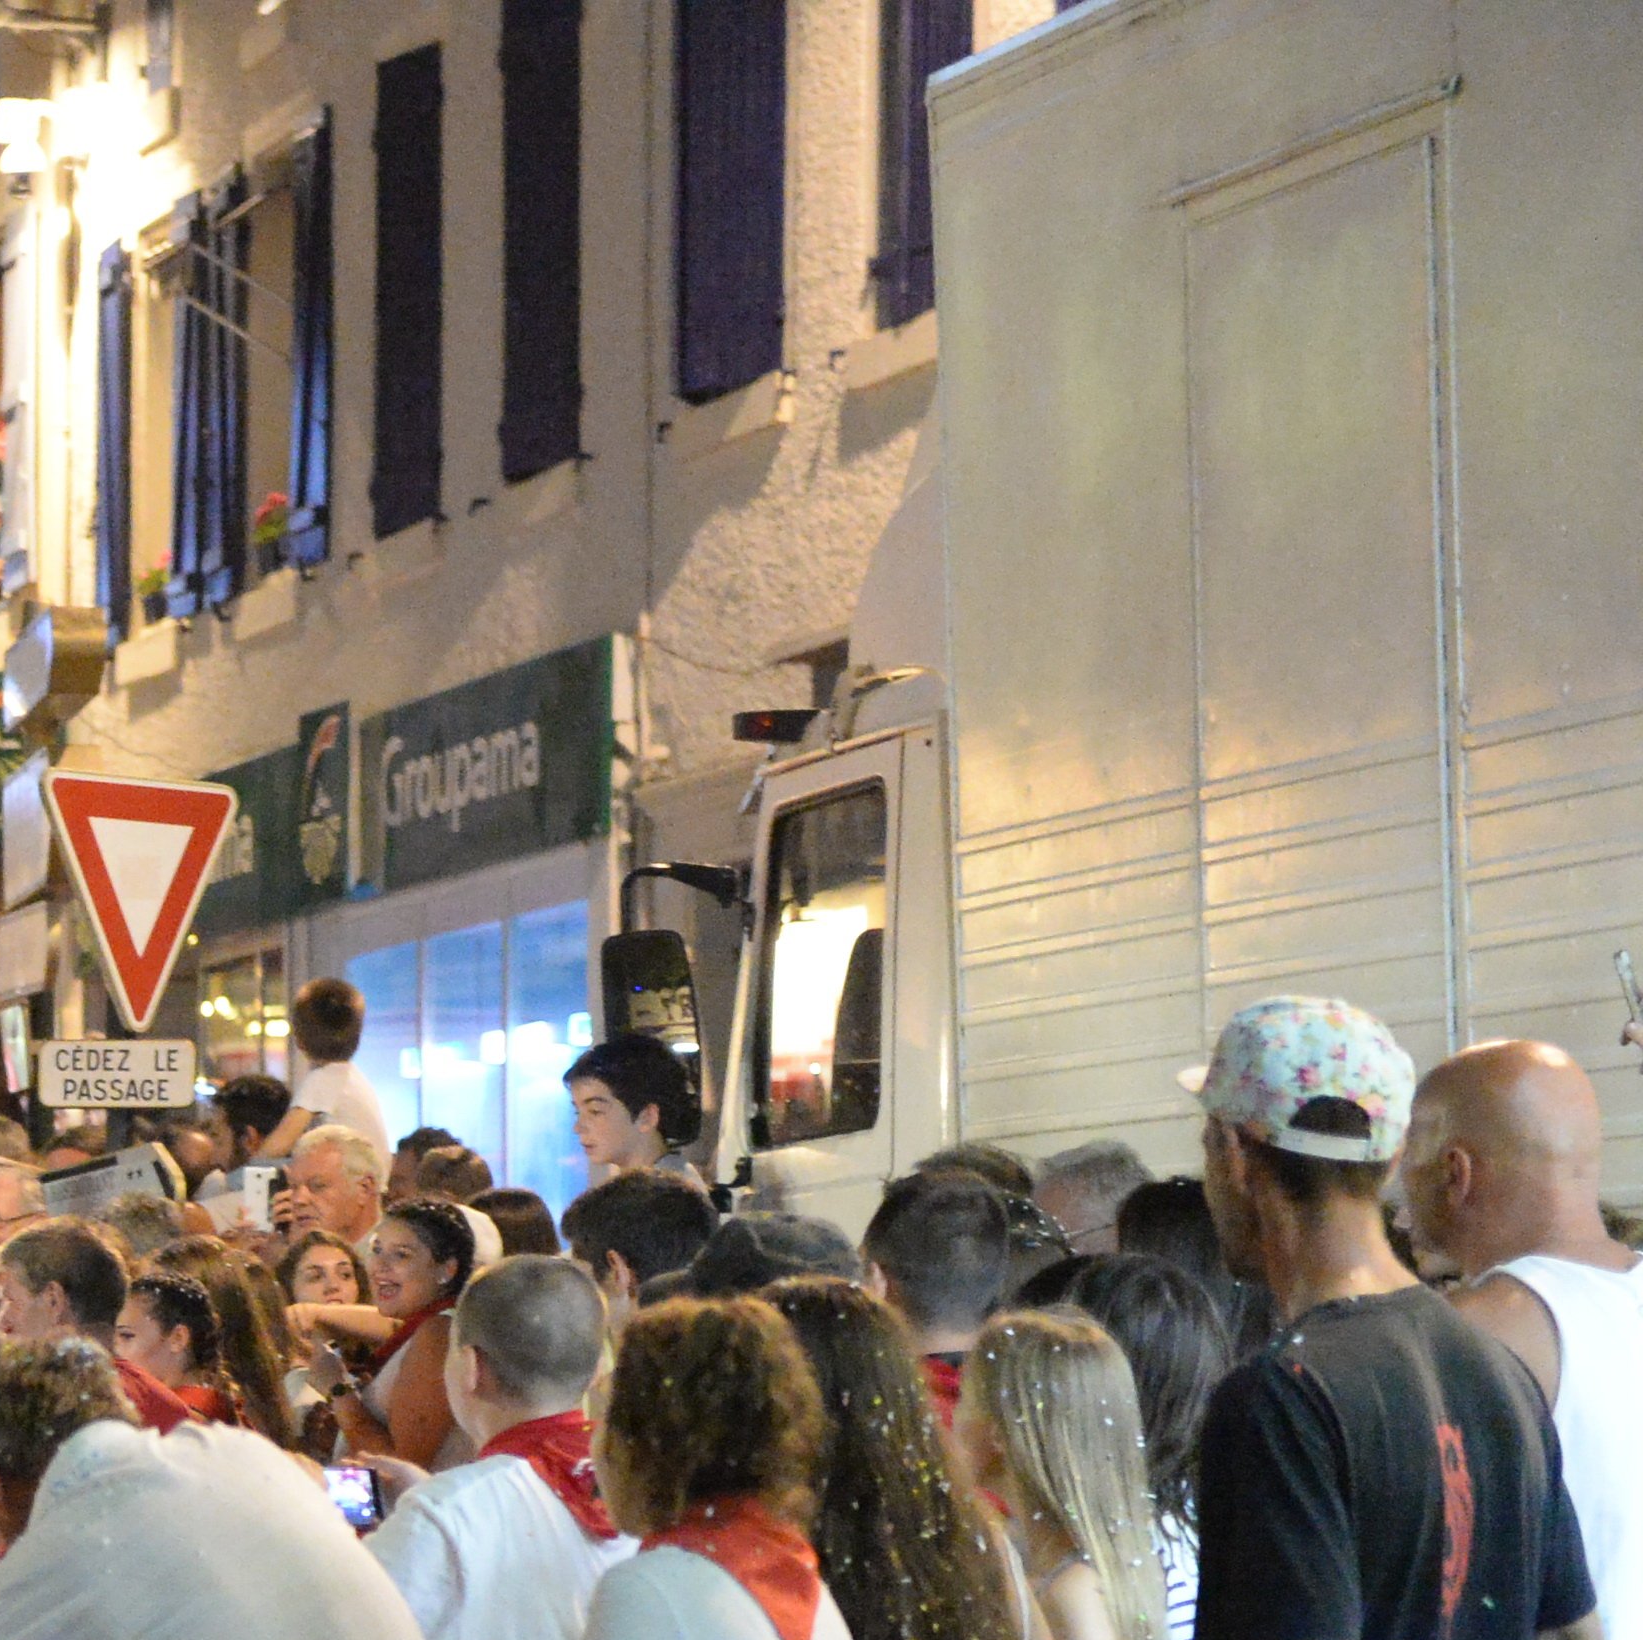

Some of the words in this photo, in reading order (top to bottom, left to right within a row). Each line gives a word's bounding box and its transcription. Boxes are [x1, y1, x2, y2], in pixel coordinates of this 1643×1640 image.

[378, 721, 540, 833] Groupama
[55, 1045, 130, 1071] CÉDEZ
[154, 1049, 178, 1071] LE
[63, 1079, 169, 1101] PASSAGE
